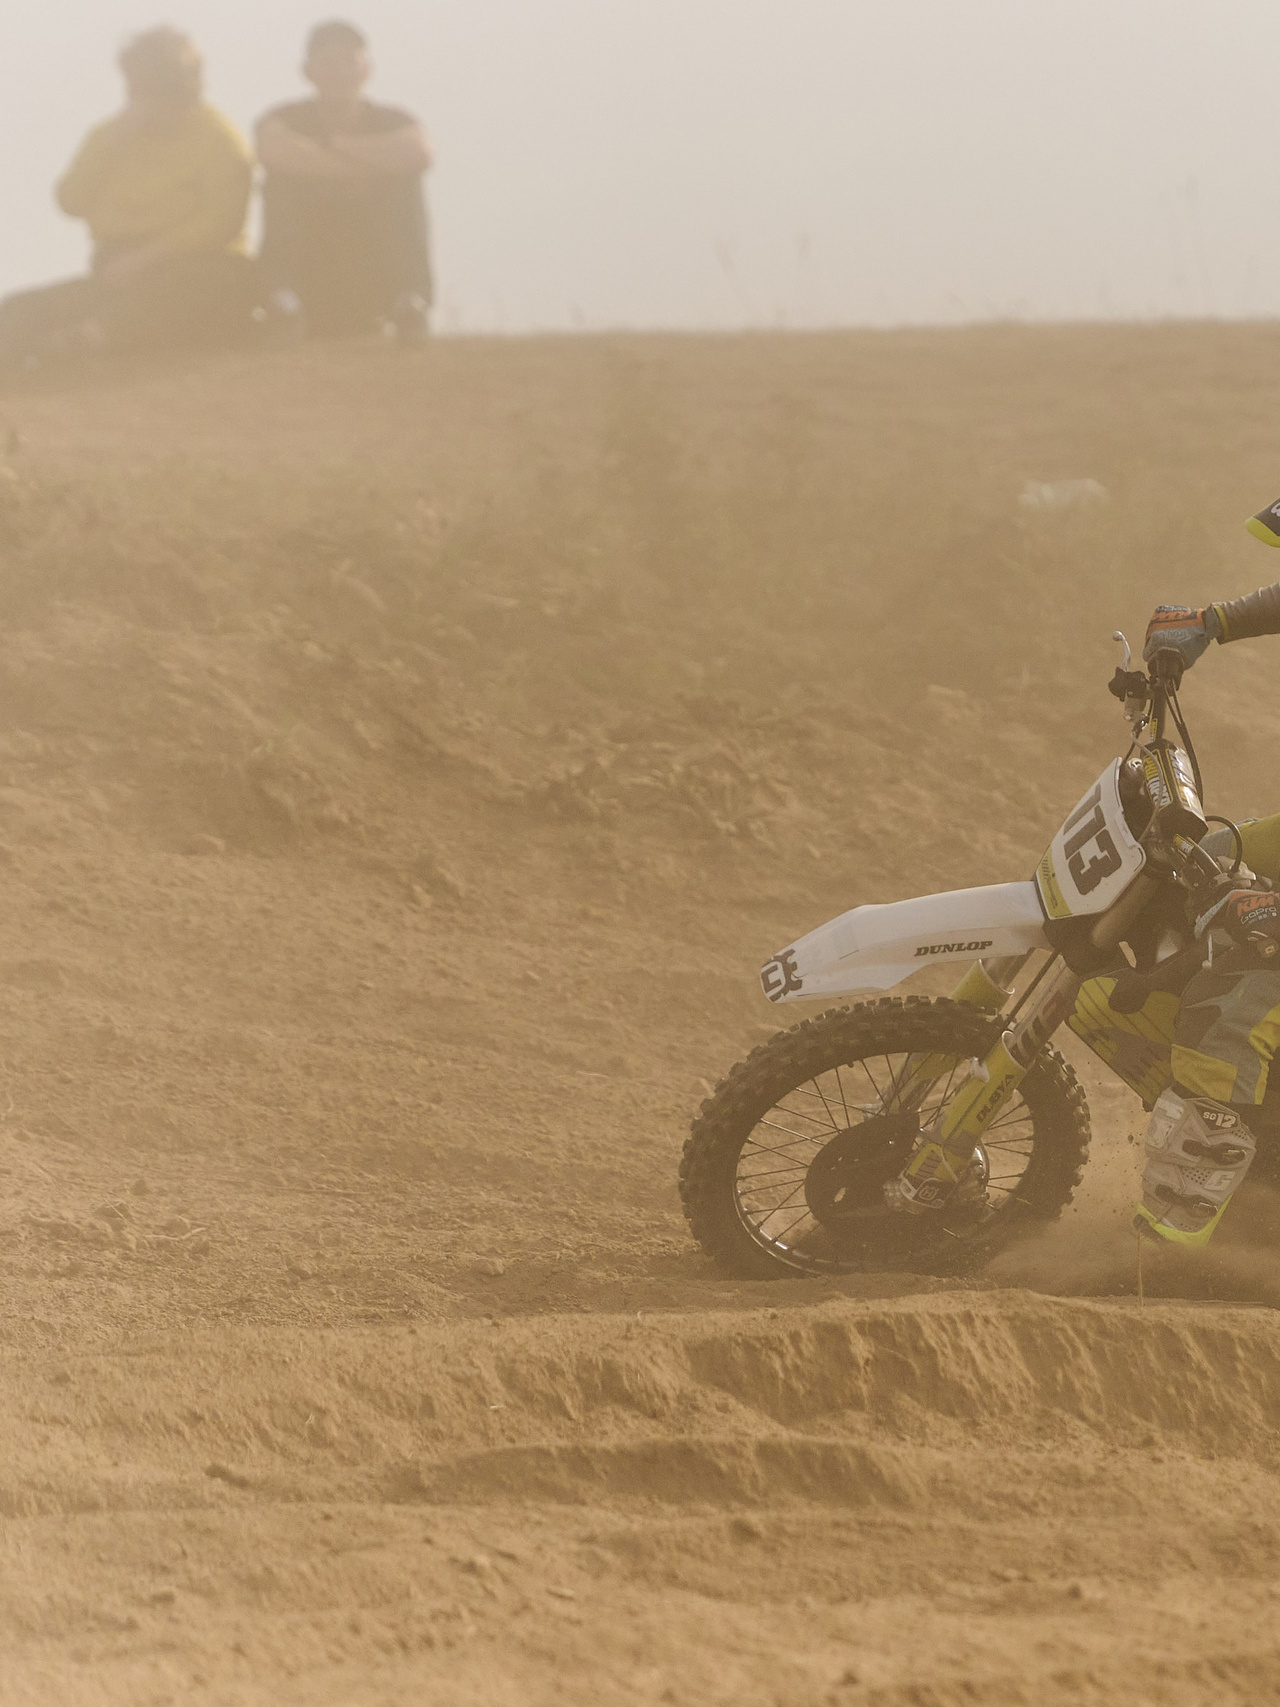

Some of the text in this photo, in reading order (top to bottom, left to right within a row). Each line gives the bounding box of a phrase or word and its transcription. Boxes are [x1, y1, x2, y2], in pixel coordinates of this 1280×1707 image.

[1063, 783, 1122, 896] 113
[1241, 906, 1277, 925] GoPro
[914, 940, 993, 957] DUNLOP
